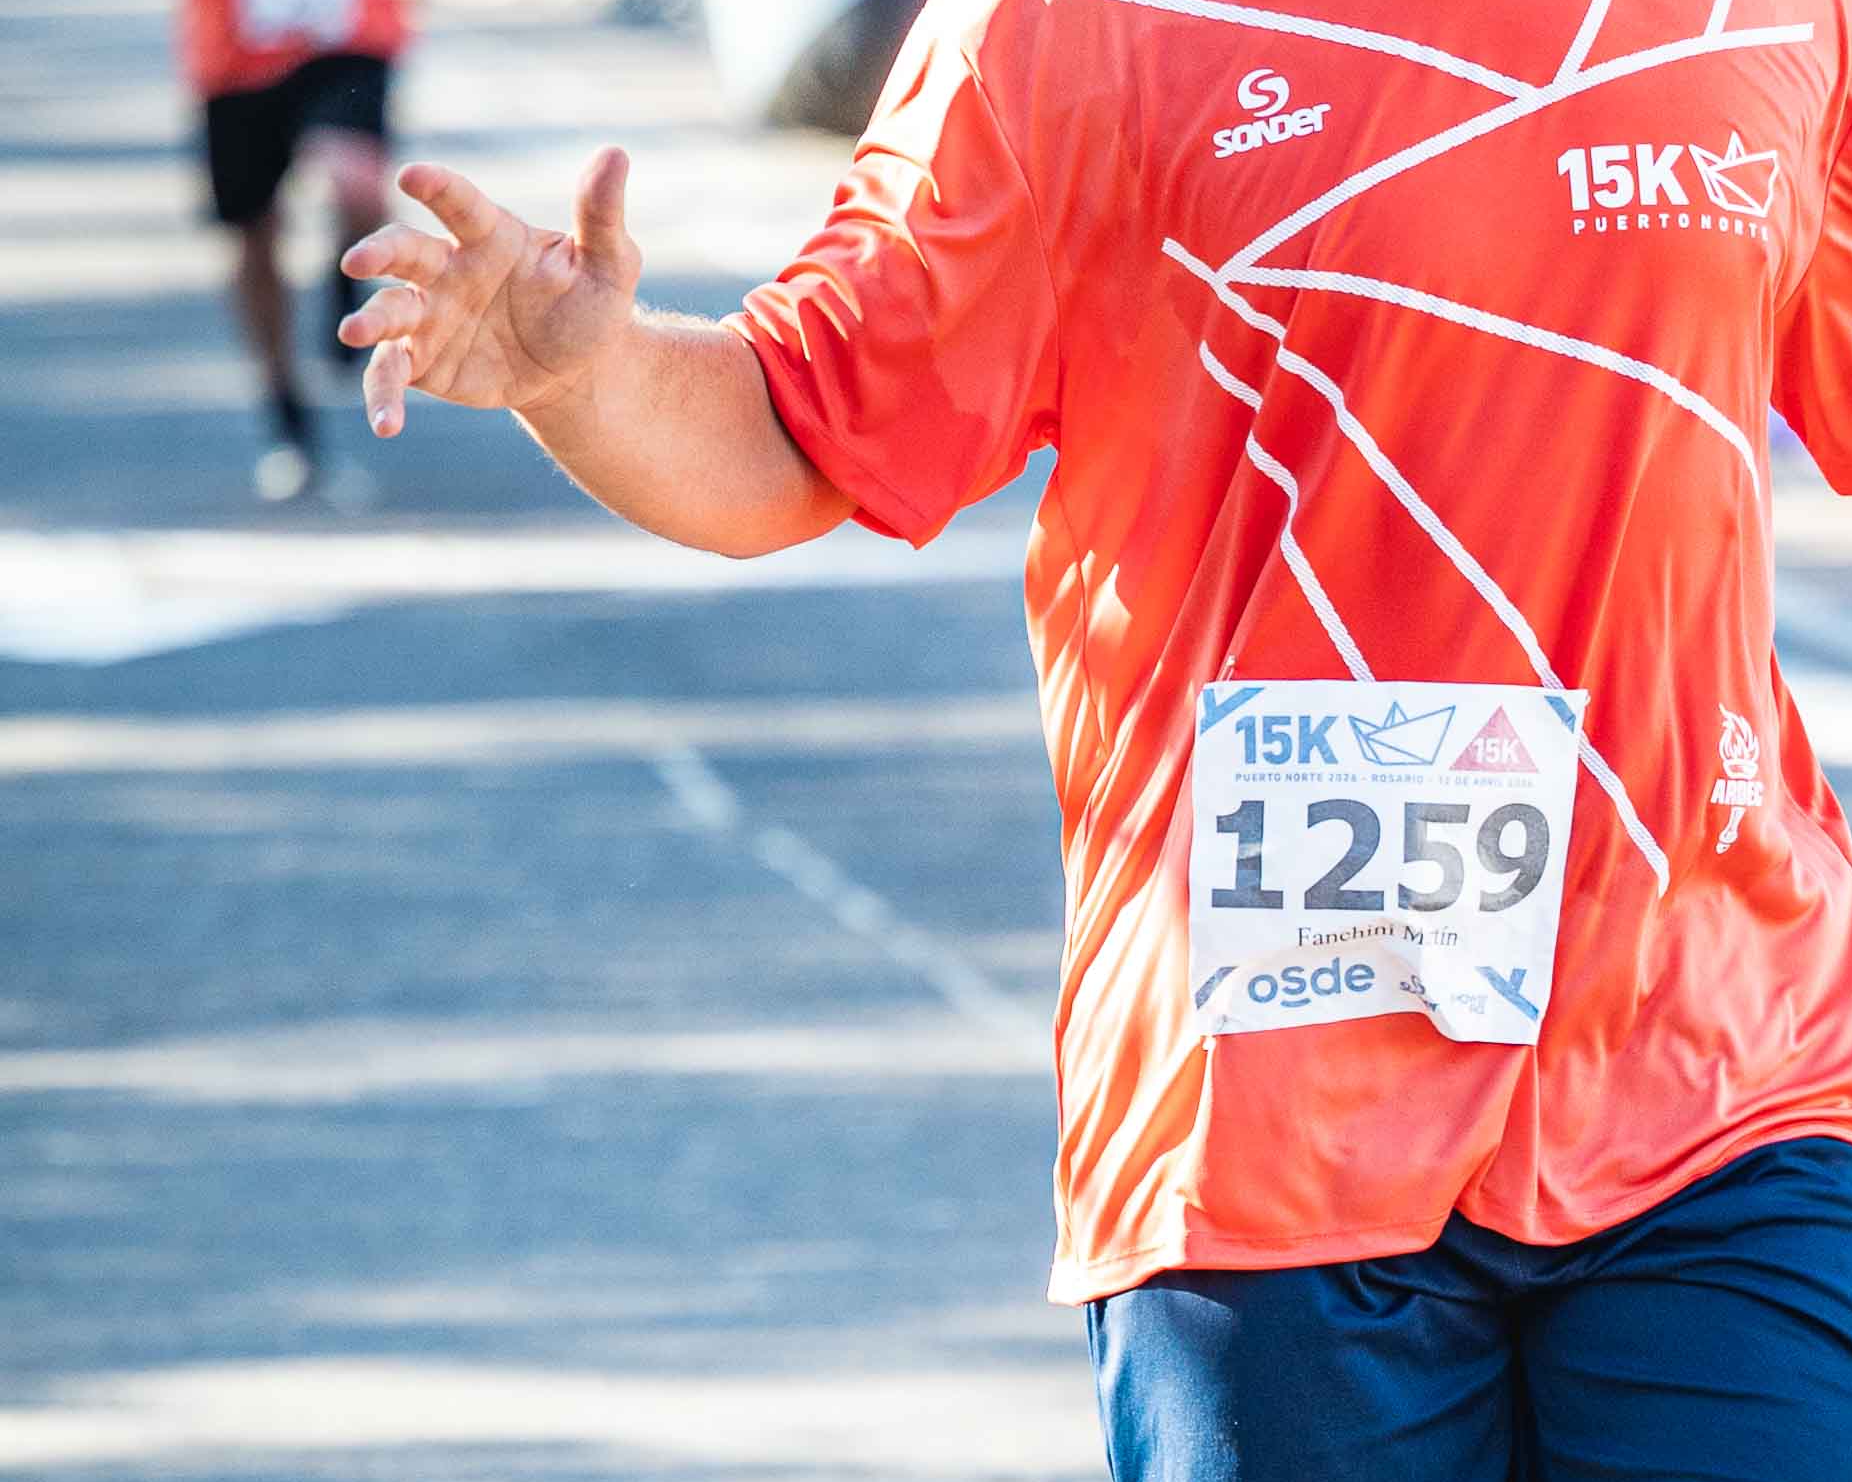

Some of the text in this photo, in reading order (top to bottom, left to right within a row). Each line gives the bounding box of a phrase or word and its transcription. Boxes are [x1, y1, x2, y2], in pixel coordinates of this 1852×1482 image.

[1557, 143, 1690, 211] 15K
[1572, 213, 1690, 235] PUERTO
[1235, 715, 1339, 765] 15K
[1472, 736, 1520, 765] 15K
[1234, 773, 1281, 782] PUERTO
[1284, 773, 1323, 782] NORTE
[1371, 773, 1424, 784] ROSARIO
[1211, 799, 1551, 912] 1259
[1247, 956, 1376, 1007] osde
